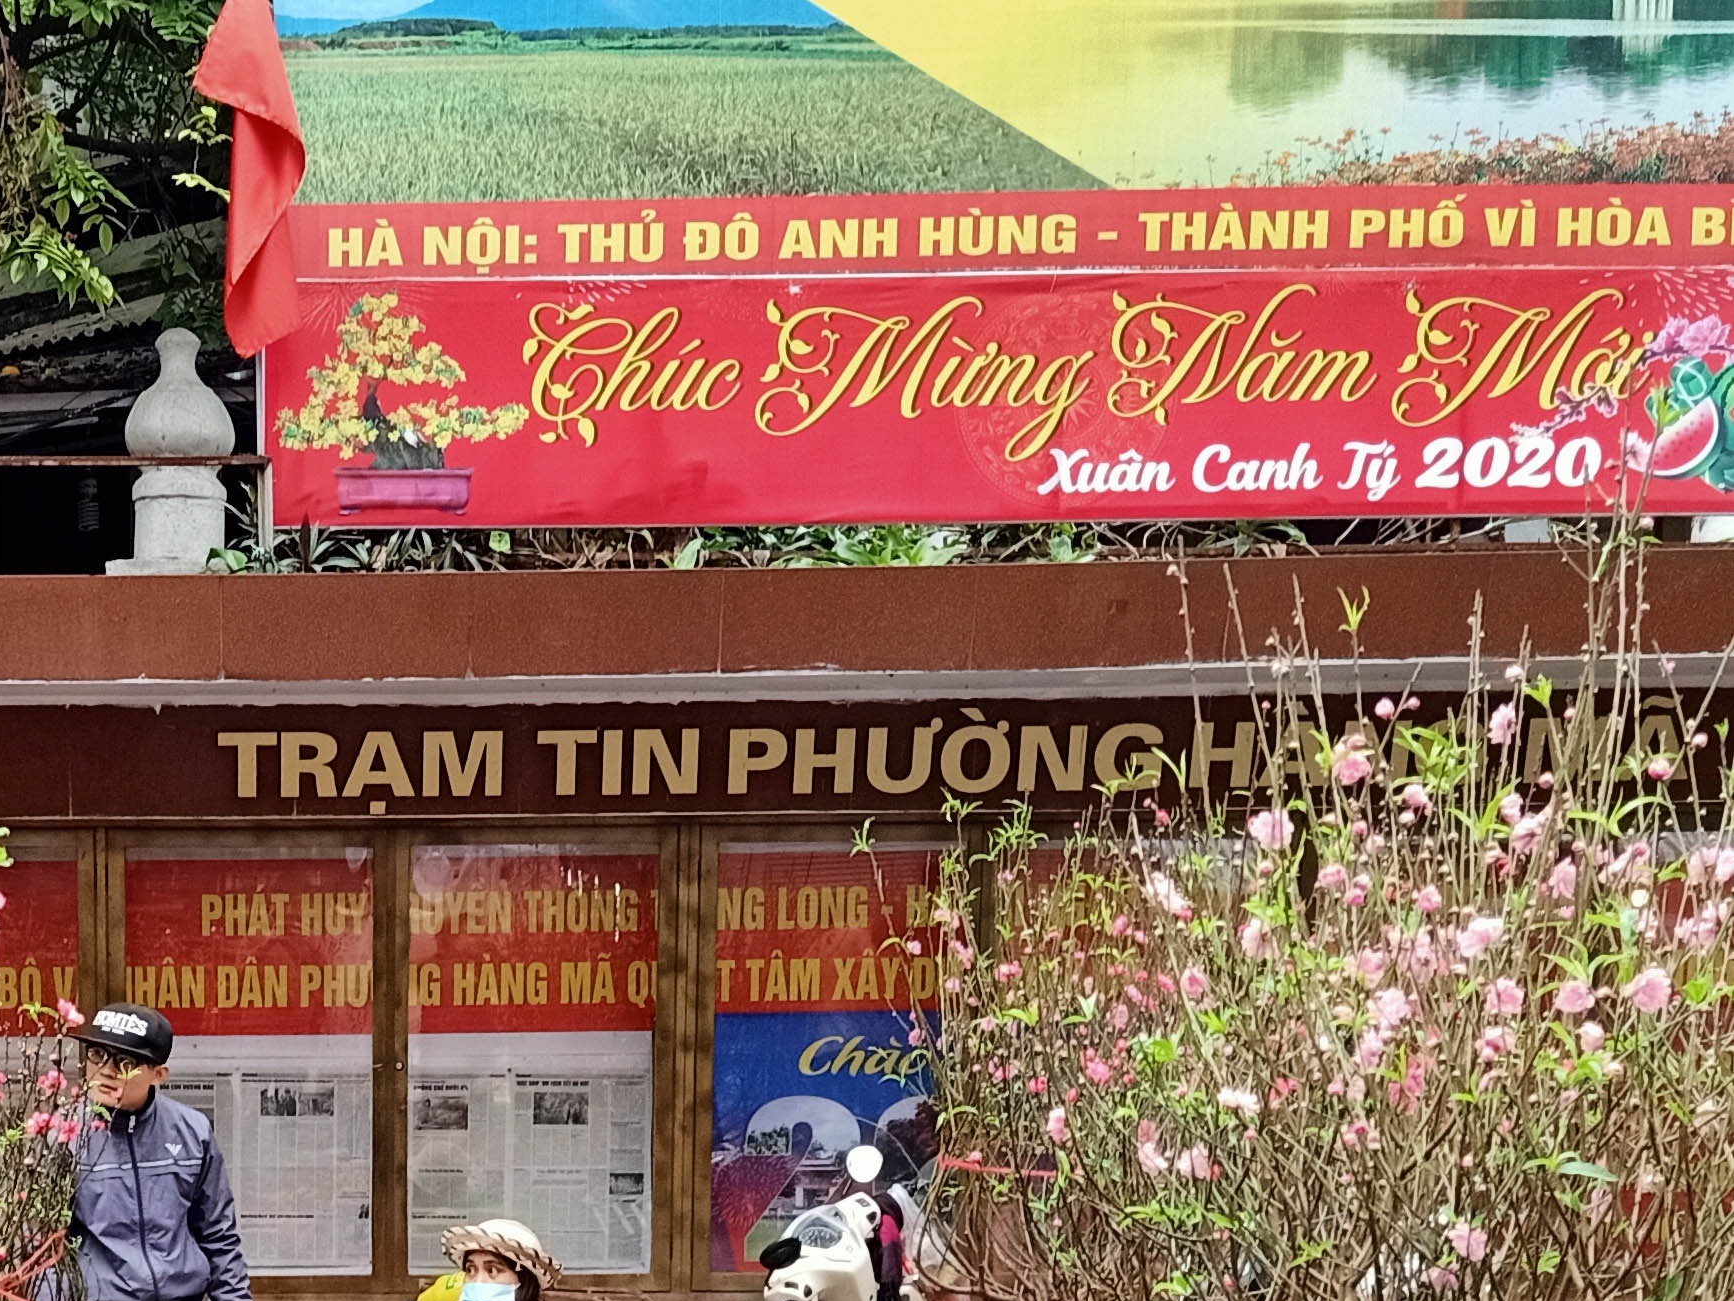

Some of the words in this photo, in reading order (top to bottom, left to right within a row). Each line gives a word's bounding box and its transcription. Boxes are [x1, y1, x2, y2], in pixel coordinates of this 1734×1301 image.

[327, 218, 403, 268] HÀ
[423, 217, 538, 274] NỘI:
[557, 210, 665, 264] THỦ
[683, 212, 760, 261] ĐÔ
[778, 218, 898, 260] ANH
[919, 207, 1077, 258] HÙNG
[1138, 202, 1330, 252] THÀNH
[1348, 192, 1467, 249] PHỐ
[1474, 206, 1537, 248] VÌ
[1556, 203, 1672, 248] HÒA
[522, 302, 744, 448] Chúc
[754, 295, 1098, 463] Mừng
[1106, 283, 1378, 428] Năm
[1390, 287, 1657, 429] Mới
[1037, 446, 1175, 496] Xuân
[1192, 440, 1324, 494] Canh
[1414, 437, 1602, 489] 2020
[218, 729, 505, 815] TRẠM
[537, 727, 700, 798] TIN
[727, 706, 1164, 796] PHƯỜNG
[202, 884, 290, 937] PHÁT
[301, 892, 367, 936] HUY
[777, 885, 868, 931] LONG
[217, 955, 288, 1008] DÂN
[453, 953, 548, 1007] HÀNG
[560, 951, 616, 1005] MÃ
[746, 949, 821, 1002] TÂM
[833, 948, 903, 1001] XÂY
